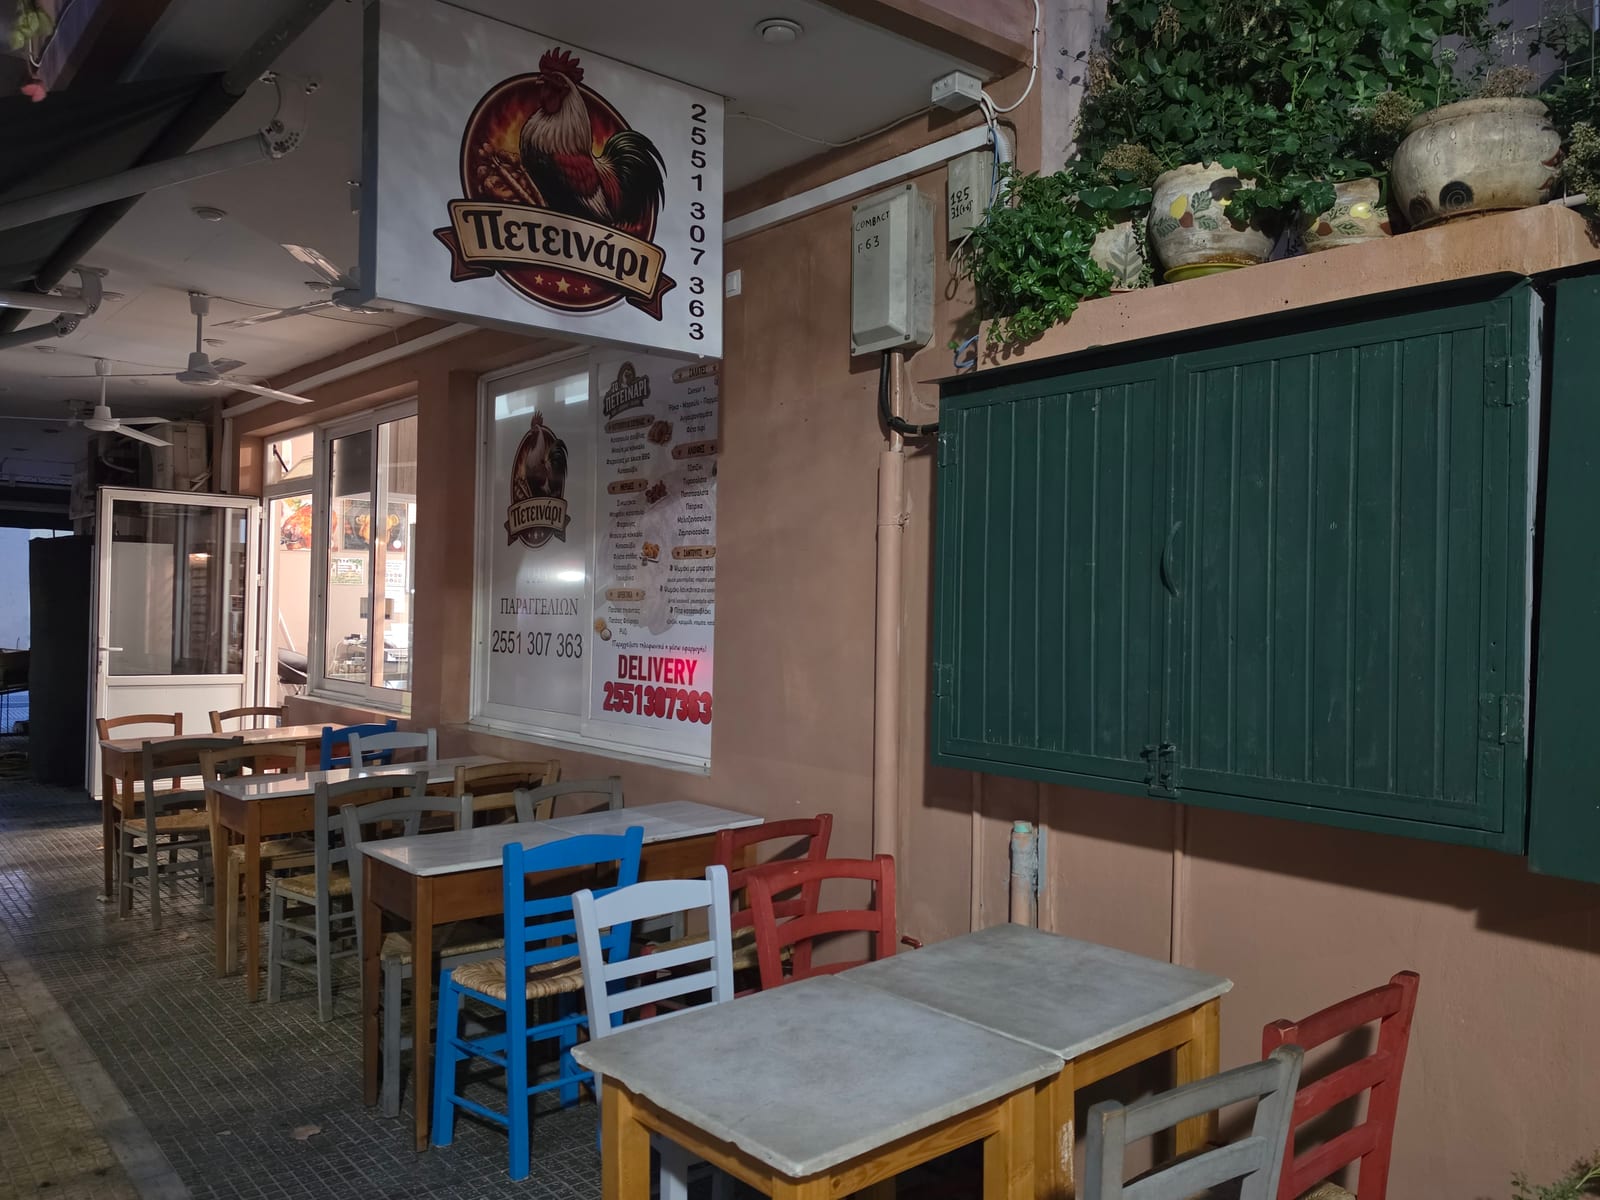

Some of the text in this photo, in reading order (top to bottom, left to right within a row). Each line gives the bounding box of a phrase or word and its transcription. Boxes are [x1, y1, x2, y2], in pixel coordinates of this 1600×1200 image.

[688, 103, 708, 340] 2551 307 363
[463, 209, 649, 283] Πετεινάρι
[866, 235, 880, 250] 63
[511, 501, 562, 527] Πετεινάρι
[500, 597, 579, 616] ΠΑΡΑΓΓΕΛΙΩΝ
[492, 629, 583, 659] 2551 307 363
[617, 654, 698, 686] DELIVERY
[603, 680, 713, 725] 2551307363
